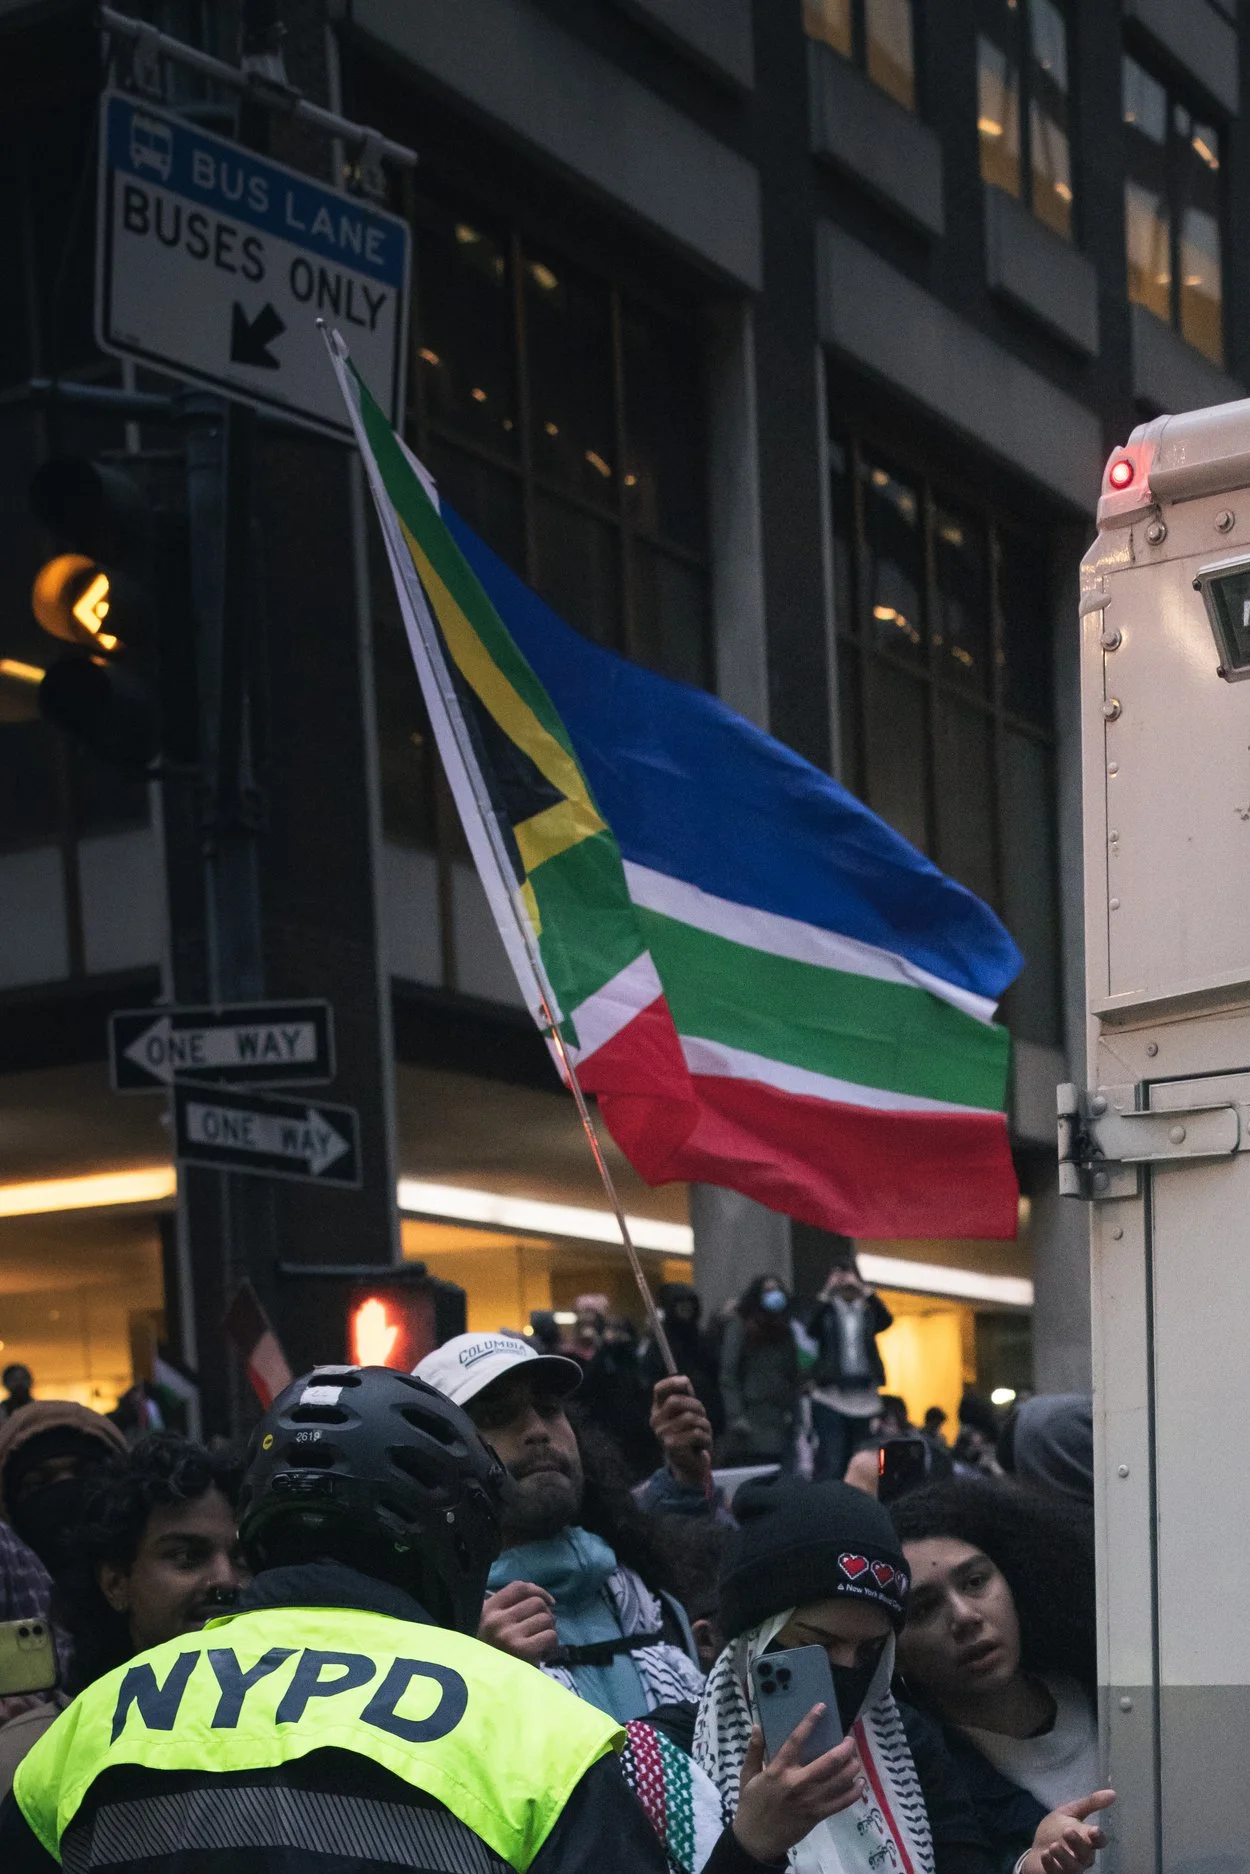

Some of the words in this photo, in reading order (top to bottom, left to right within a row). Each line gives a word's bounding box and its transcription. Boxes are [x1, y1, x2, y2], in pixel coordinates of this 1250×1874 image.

[192, 151, 270, 213] BUS
[286, 191, 388, 266] LANE
[123, 185, 266, 283] BUSES
[290, 257, 388, 332] ONLY
[145, 1034, 205, 1066] ONE
[236, 1029, 302, 1061] WAY
[202, 1111, 257, 1149] ONE
[281, 1125, 333, 1155] WAY
[458, 1340, 526, 1364] COLUMBIA
[846, 1583, 863, 1594] New
[110, 1647, 469, 1746] NYPD
